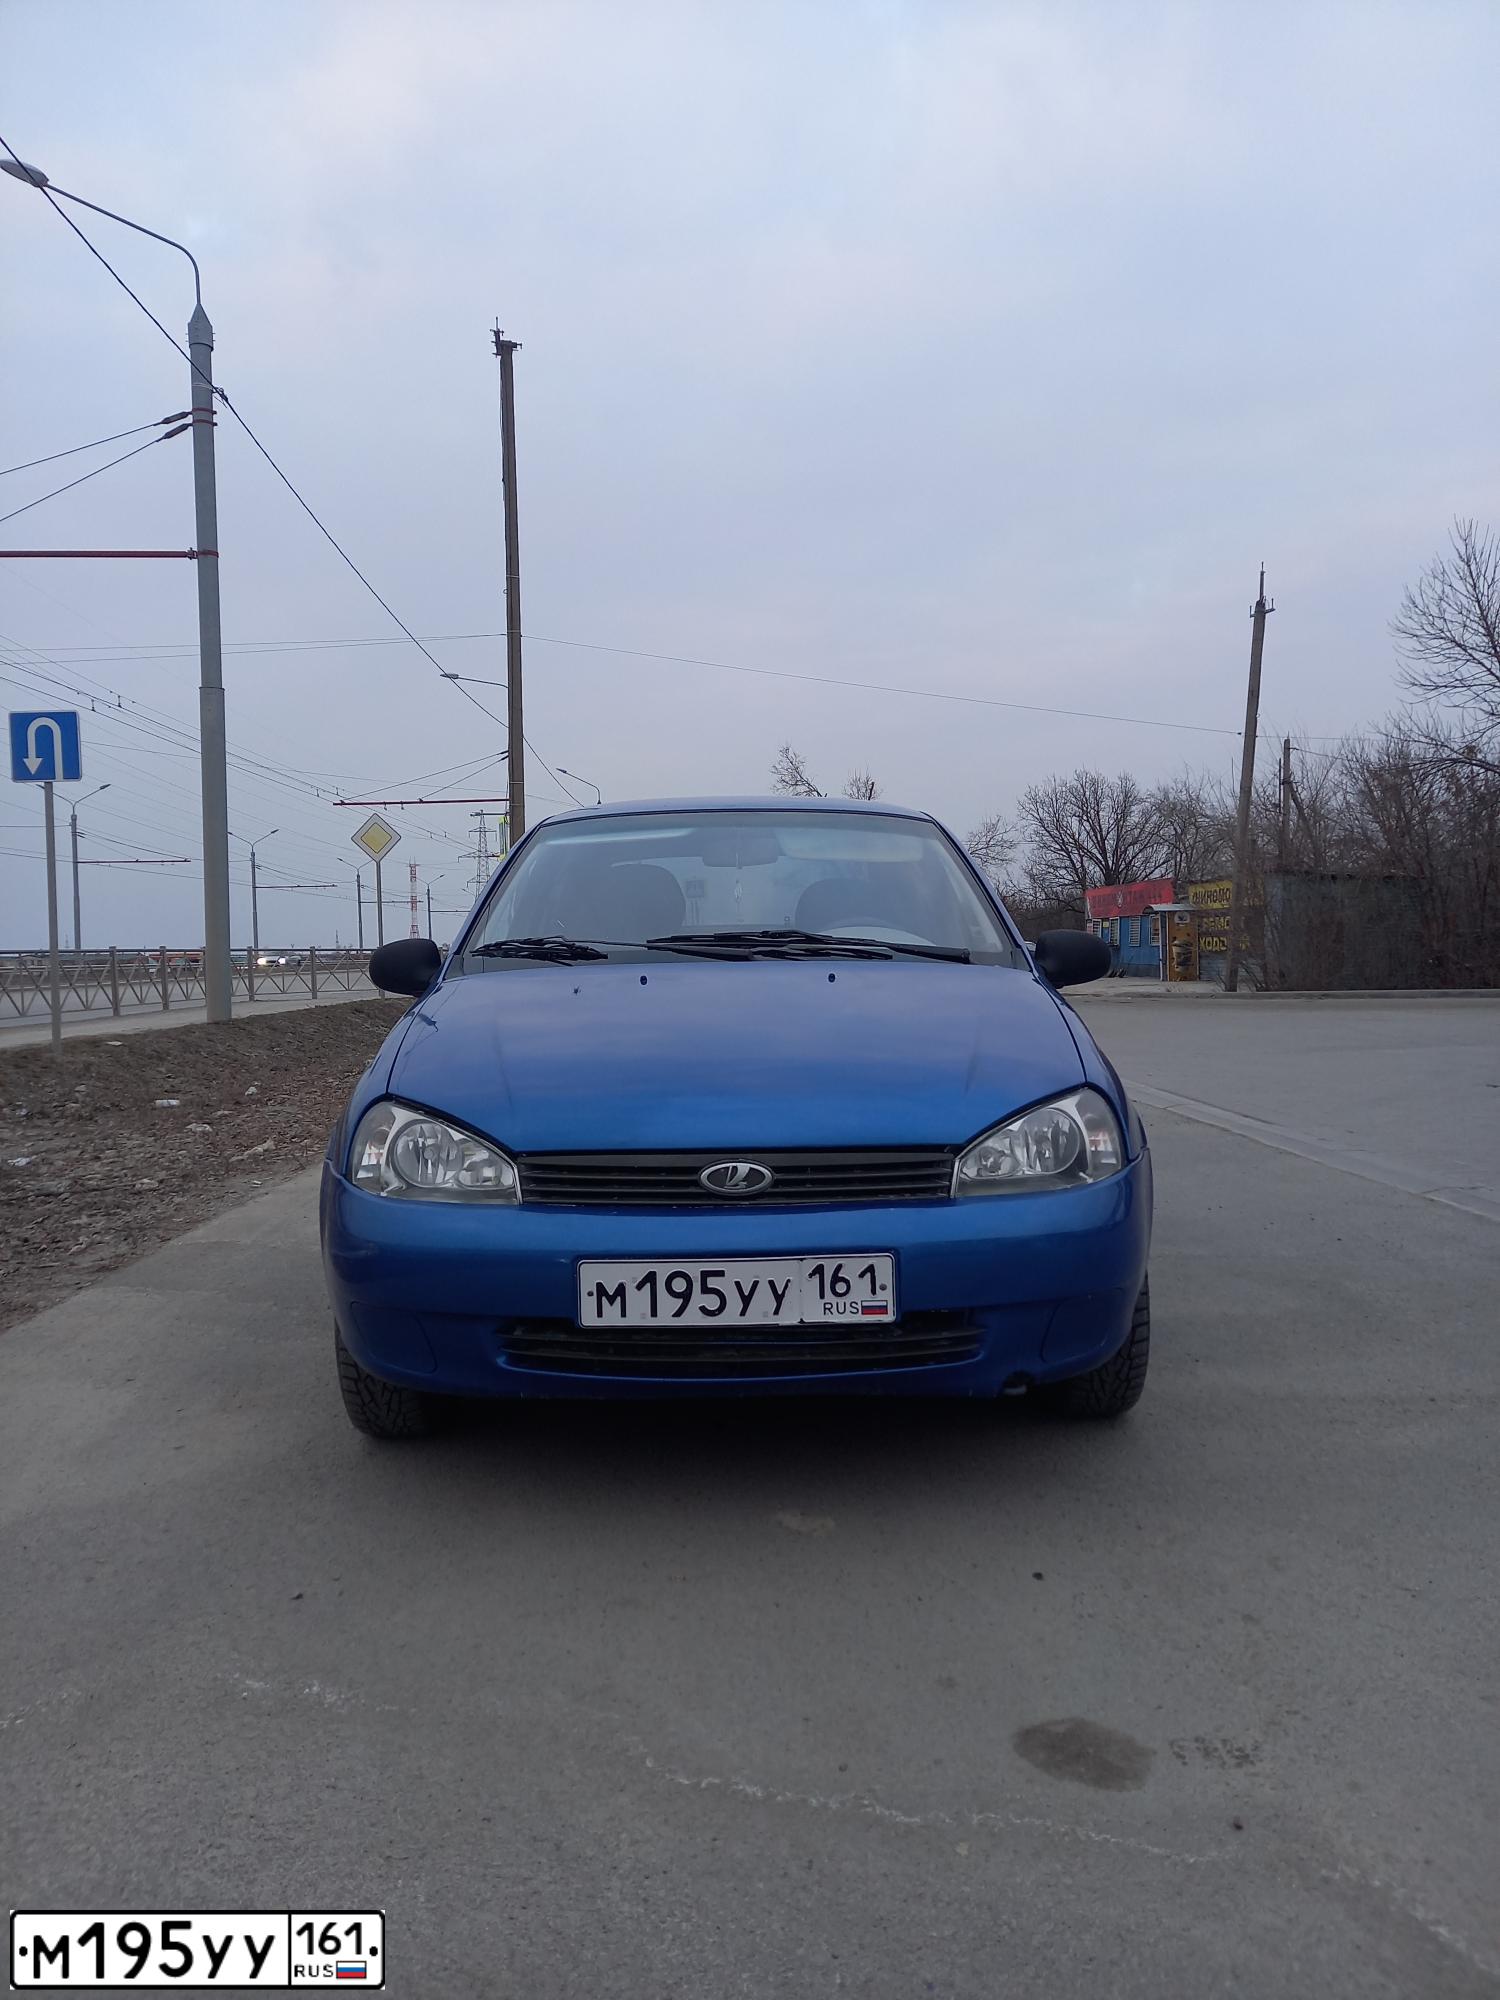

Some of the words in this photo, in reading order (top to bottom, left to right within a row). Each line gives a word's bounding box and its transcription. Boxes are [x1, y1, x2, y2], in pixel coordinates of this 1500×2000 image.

[595, 1269, 791, 1318] М195УУ
[807, 1263, 878, 1300] 161
[823, 1301, 859, 1315] RUS
